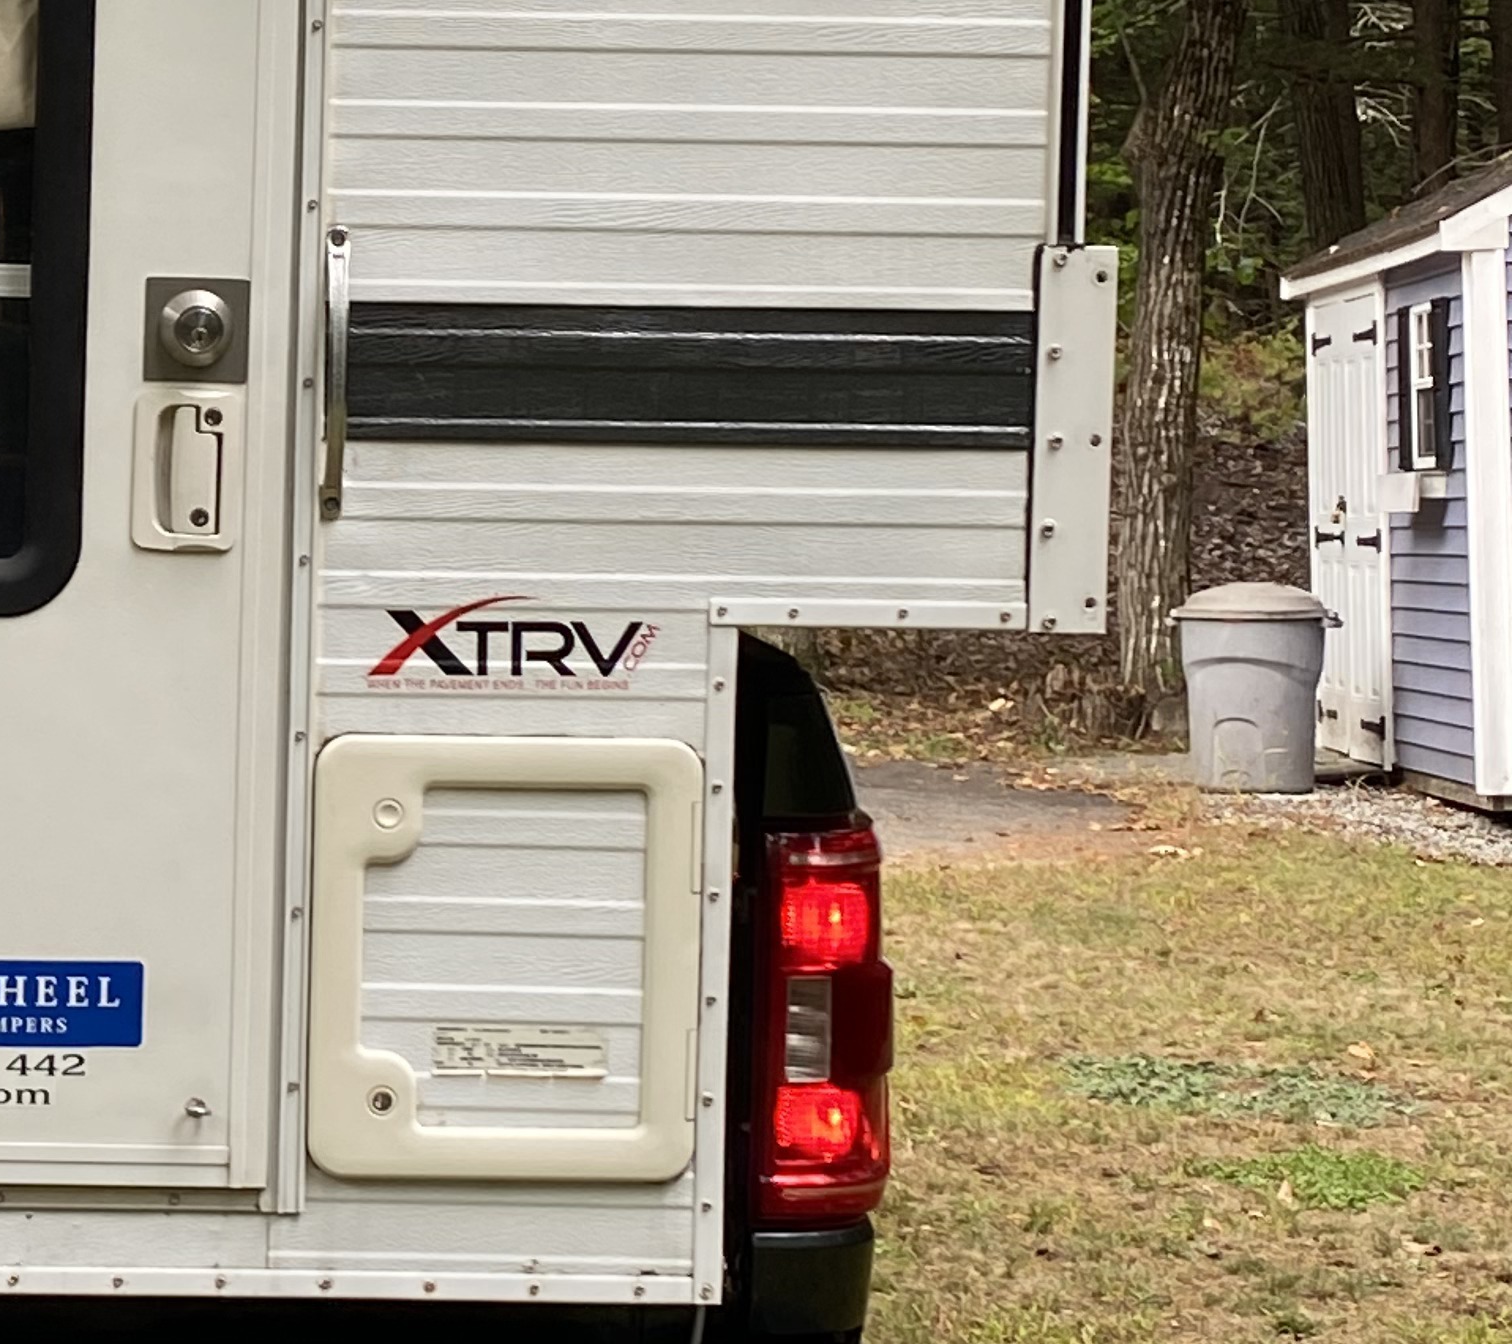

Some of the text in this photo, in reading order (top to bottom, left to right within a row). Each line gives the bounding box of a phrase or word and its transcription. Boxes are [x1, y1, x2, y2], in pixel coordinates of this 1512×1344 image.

[368, 596, 643, 677] XTRV
[367, 678, 400, 689] WHEN
[405, 678, 425, 689] THE
[430, 679, 489, 690] PAVEMENT
[535, 679, 556, 690] THE
[560, 679, 583, 690] FUN
